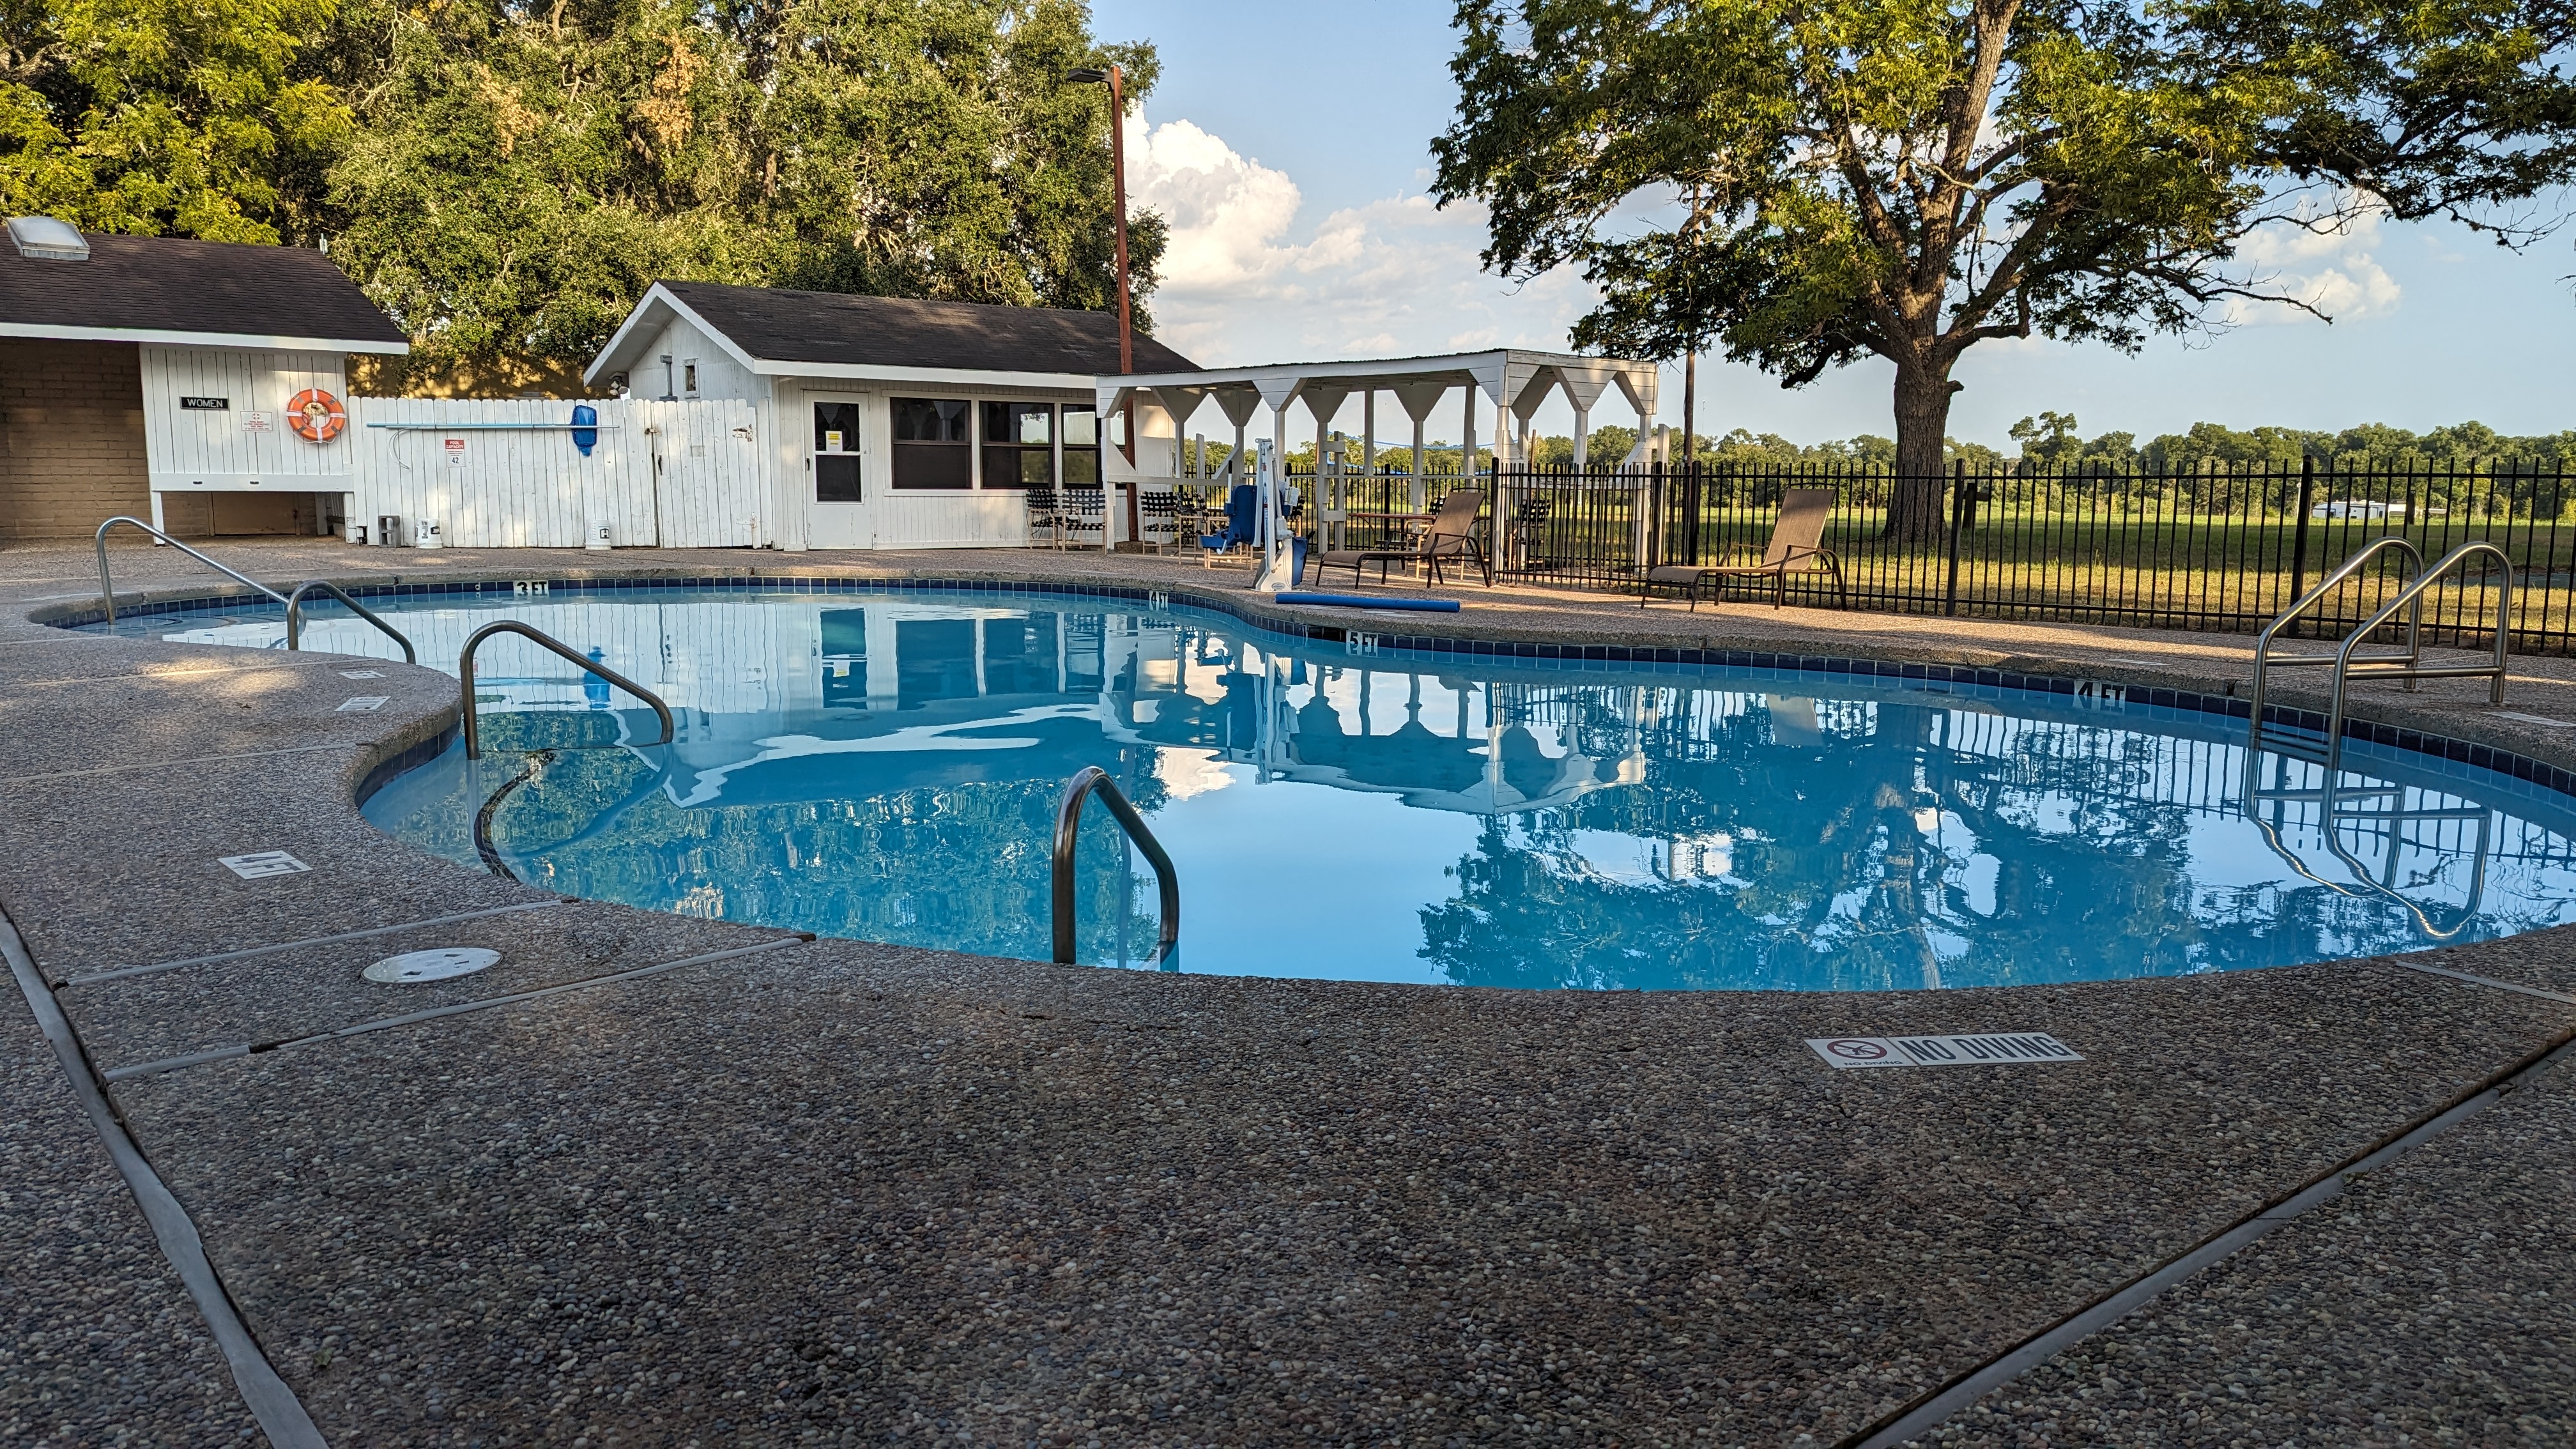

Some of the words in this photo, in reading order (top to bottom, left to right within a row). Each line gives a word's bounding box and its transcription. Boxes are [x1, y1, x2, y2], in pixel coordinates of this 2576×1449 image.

[187, 399, 223, 408] WOMEN
[517, 582, 528, 595] 3
[532, 581, 548, 595] FT
[234, 855, 282, 864] 4
[242, 862, 302, 875] FT
[1899, 1039, 1957, 1061] NO
[1952, 1036, 2072, 1059] DIVING
